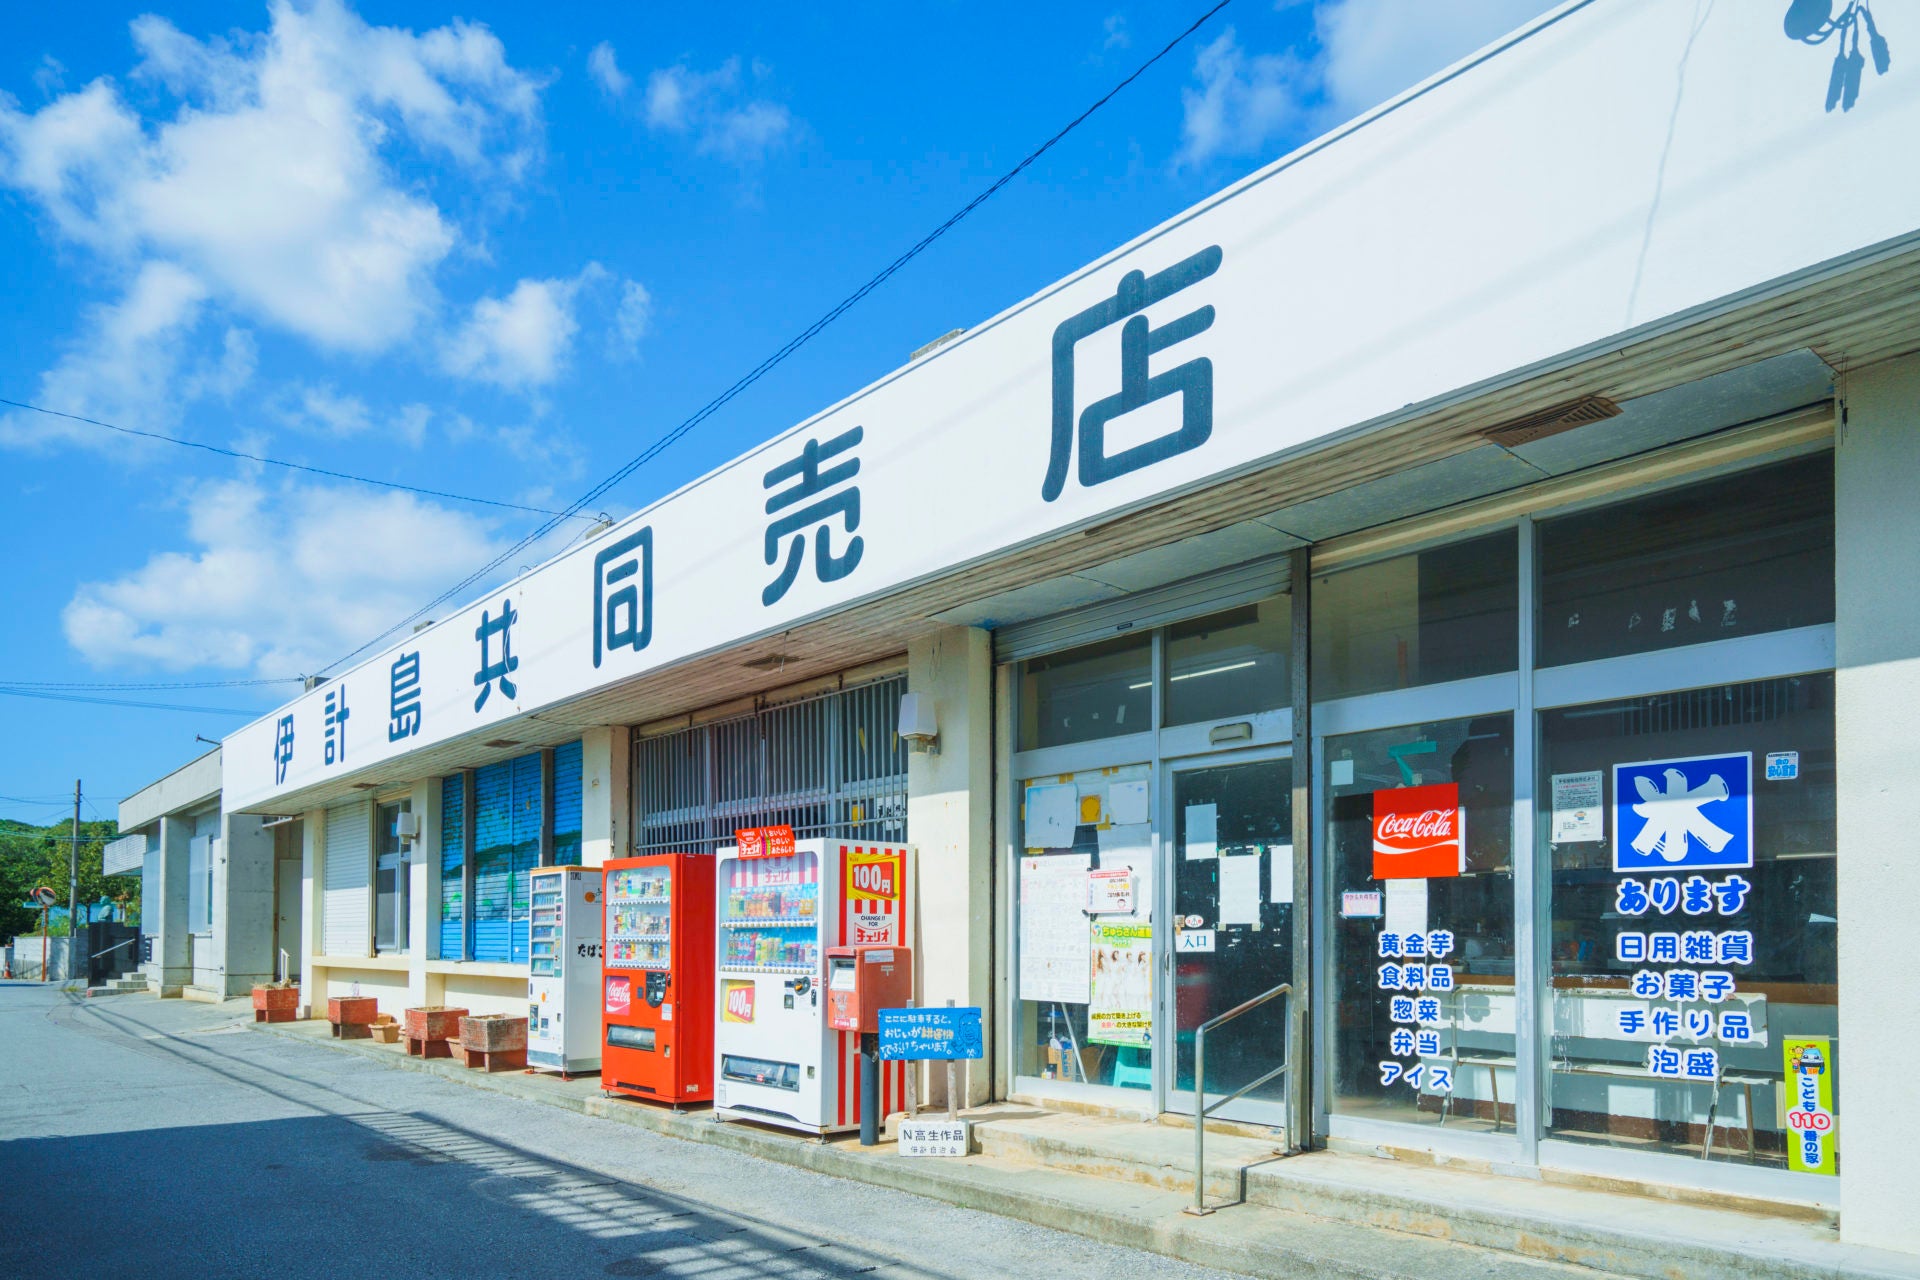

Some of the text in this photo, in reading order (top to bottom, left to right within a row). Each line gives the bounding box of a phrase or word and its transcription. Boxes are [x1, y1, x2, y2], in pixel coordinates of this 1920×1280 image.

[273, 245, 1223, 785] 伊計島共同売店
[1377, 808, 1456, 840] Coca-Cola
[853, 864, 891, 894] 100円
[1617, 877, 1749, 914] あります
[856, 927, 889, 943] チェリオ
[1184, 934, 1207, 949] 入口
[1380, 932, 1451, 955] 黄金芋
[1620, 933, 1750, 962] 日用雑貨
[1380, 965, 1451, 988] 食料品
[1635, 972, 1733, 1000] お菓子
[728, 989, 752, 1018] 100円
[1392, 999, 1439, 1022] 惣菜
[1619, 1009, 1750, 1040] 手作り品
[1393, 1031, 1438, 1055] 弁当
[1381, 1062, 1451, 1089] アイス
[1652, 1048, 1716, 1078] 泡盛
